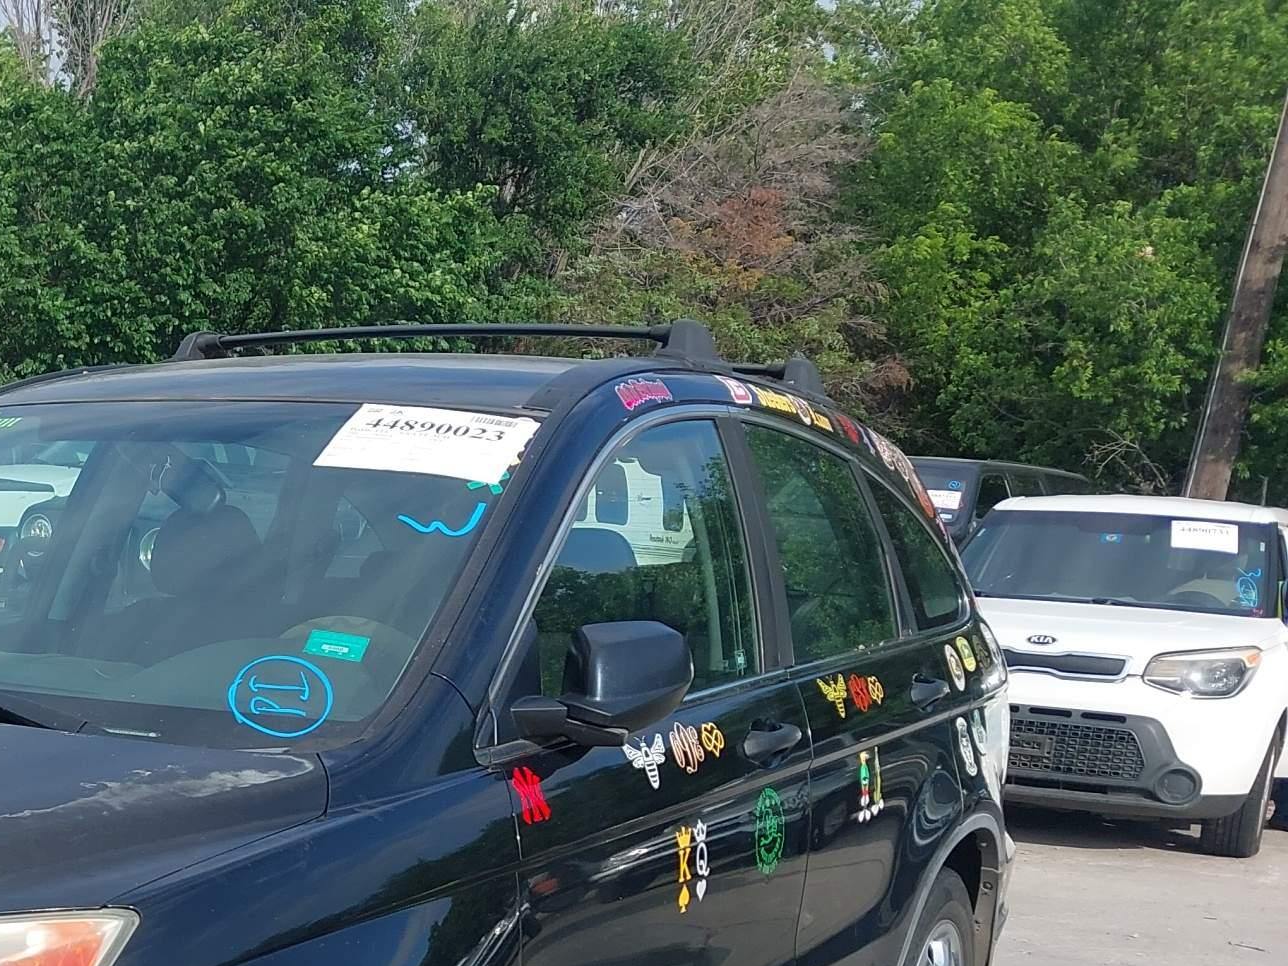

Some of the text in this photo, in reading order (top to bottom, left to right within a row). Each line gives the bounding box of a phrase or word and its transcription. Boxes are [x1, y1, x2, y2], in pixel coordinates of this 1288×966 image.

[365, 417, 506, 442] 44890023
[1030, 635, 1053, 644] KIA
[678, 847, 692, 883] K
[696, 841, 710, 877] Q
